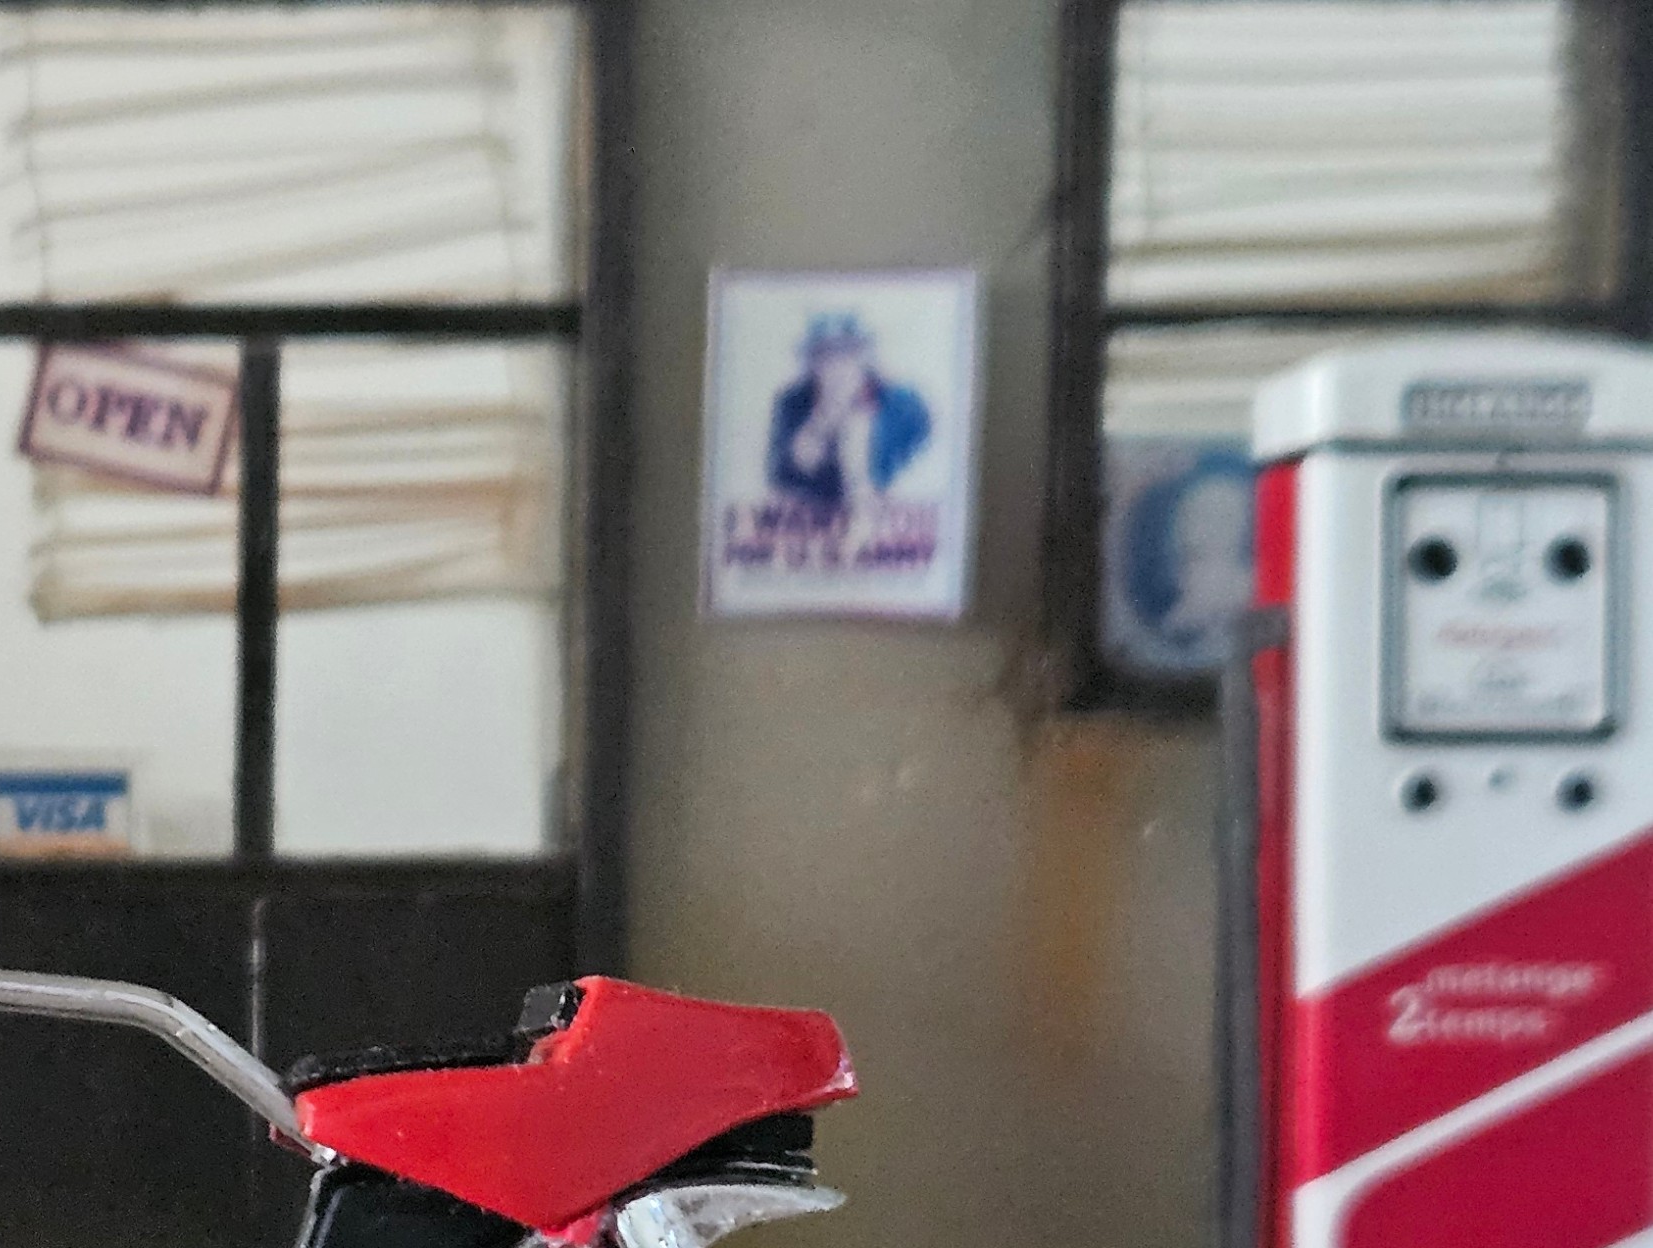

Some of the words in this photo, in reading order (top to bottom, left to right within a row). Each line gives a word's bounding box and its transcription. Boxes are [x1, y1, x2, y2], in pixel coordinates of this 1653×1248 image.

[45, 379, 210, 448] OPEN
[14, 796, 108, 833] VISA
[1389, 983, 1427, 1043] 2
